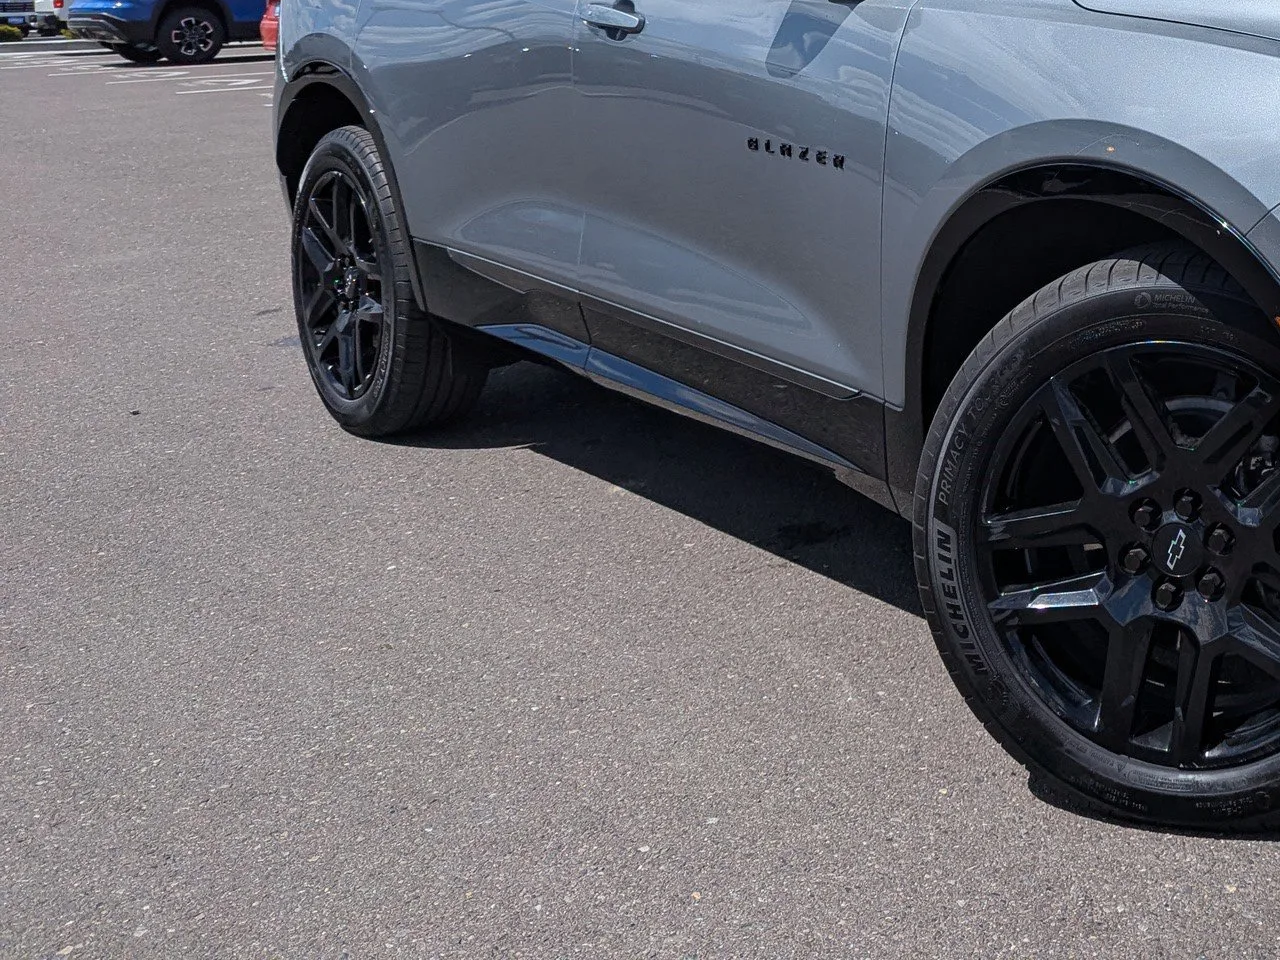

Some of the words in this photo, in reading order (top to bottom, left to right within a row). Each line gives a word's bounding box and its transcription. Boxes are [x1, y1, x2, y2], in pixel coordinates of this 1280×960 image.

[747, 137, 845, 170] BLAZER
[1154, 294, 1196, 304] MICHELIN
[938, 422, 968, 506] PRIMACY
[936, 528, 989, 676] MICHELIN
